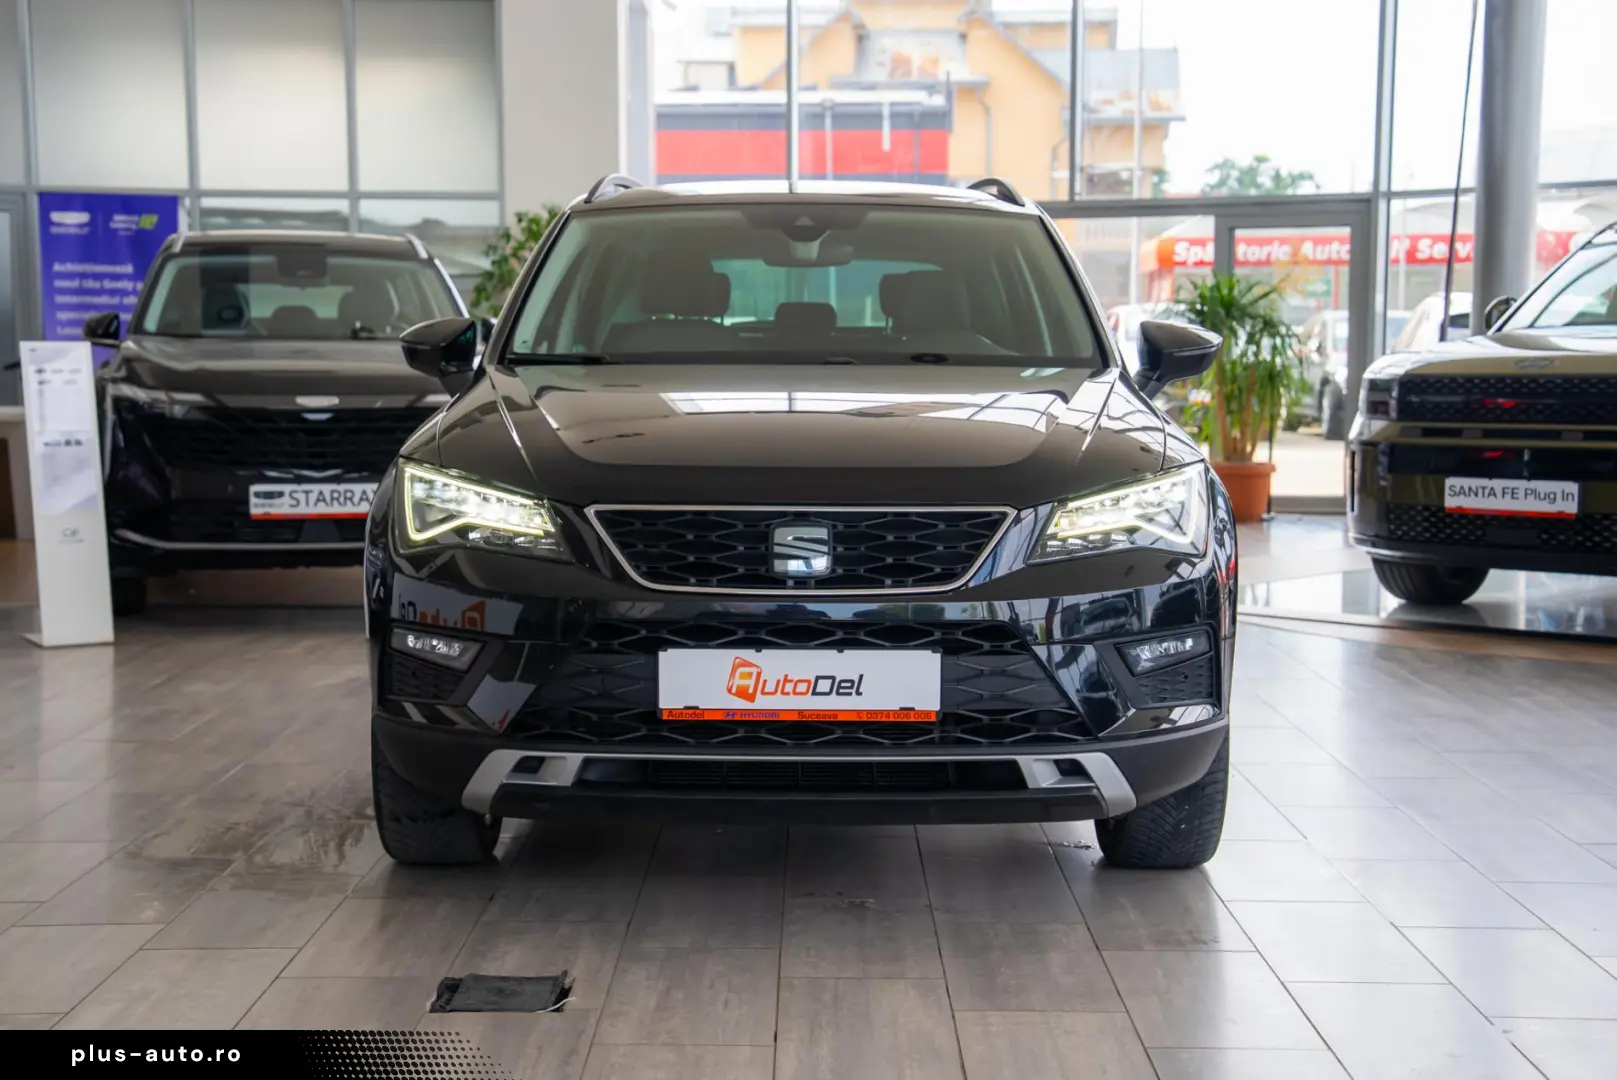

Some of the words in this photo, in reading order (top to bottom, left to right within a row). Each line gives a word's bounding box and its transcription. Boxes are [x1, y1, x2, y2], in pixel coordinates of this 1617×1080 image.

[1447, 484, 1497, 499] SANTA
[1501, 486, 1519, 500] FE
[1524, 487, 1557, 504] Plug
[1562, 489, 1575, 502] In
[728, 661, 864, 699] AutoDel
[797, 711, 839, 720] Suceava
